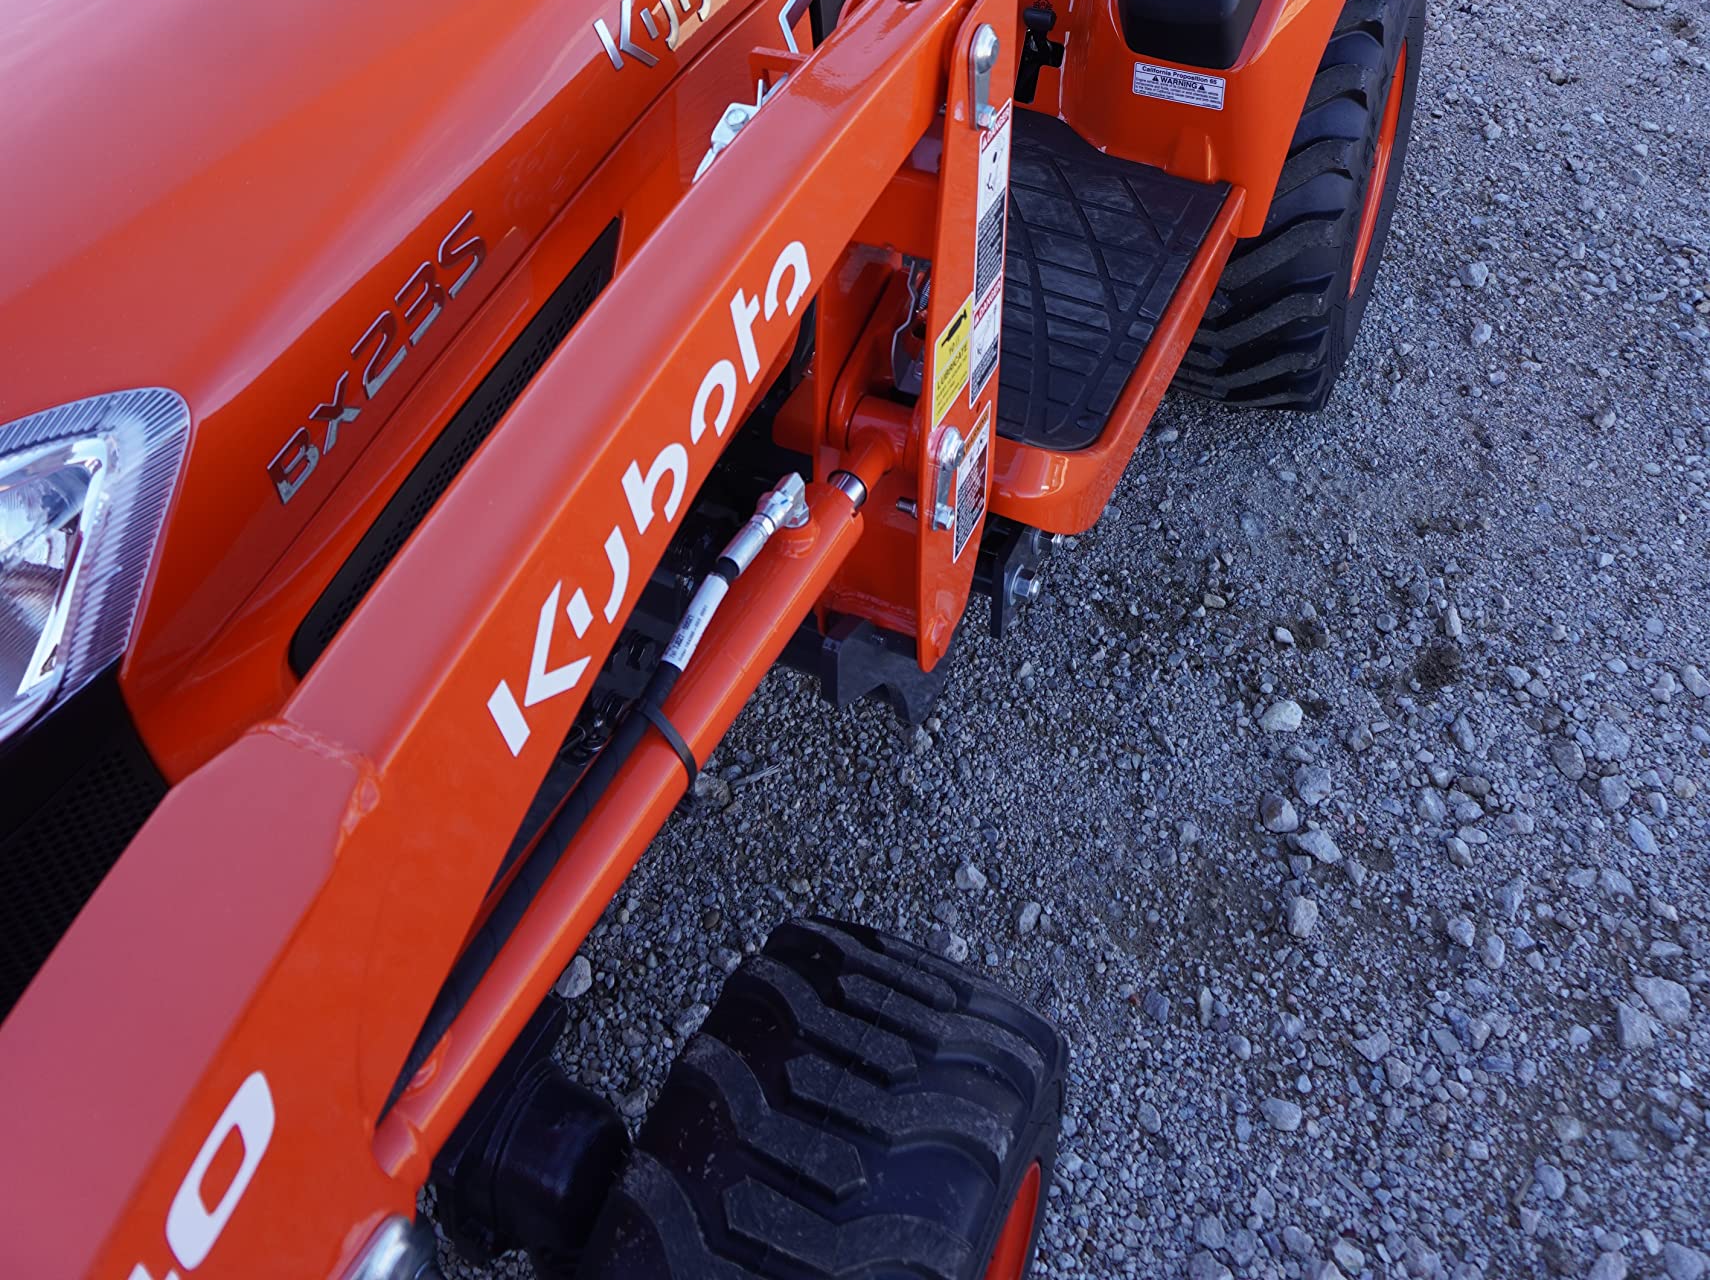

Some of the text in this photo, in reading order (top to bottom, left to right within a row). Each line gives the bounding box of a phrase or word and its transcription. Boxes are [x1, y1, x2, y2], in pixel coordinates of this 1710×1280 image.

[1142, 65, 1171, 76] California
[1172, 71, 1208, 83] Proposition
[1160, 75, 1197, 89] WARNING
[979, 280, 1001, 318] DANGER
[267, 210, 487, 505] BX23S
[936, 343, 968, 390] LUBRICATE
[486, 240, 812, 758] Kubota
